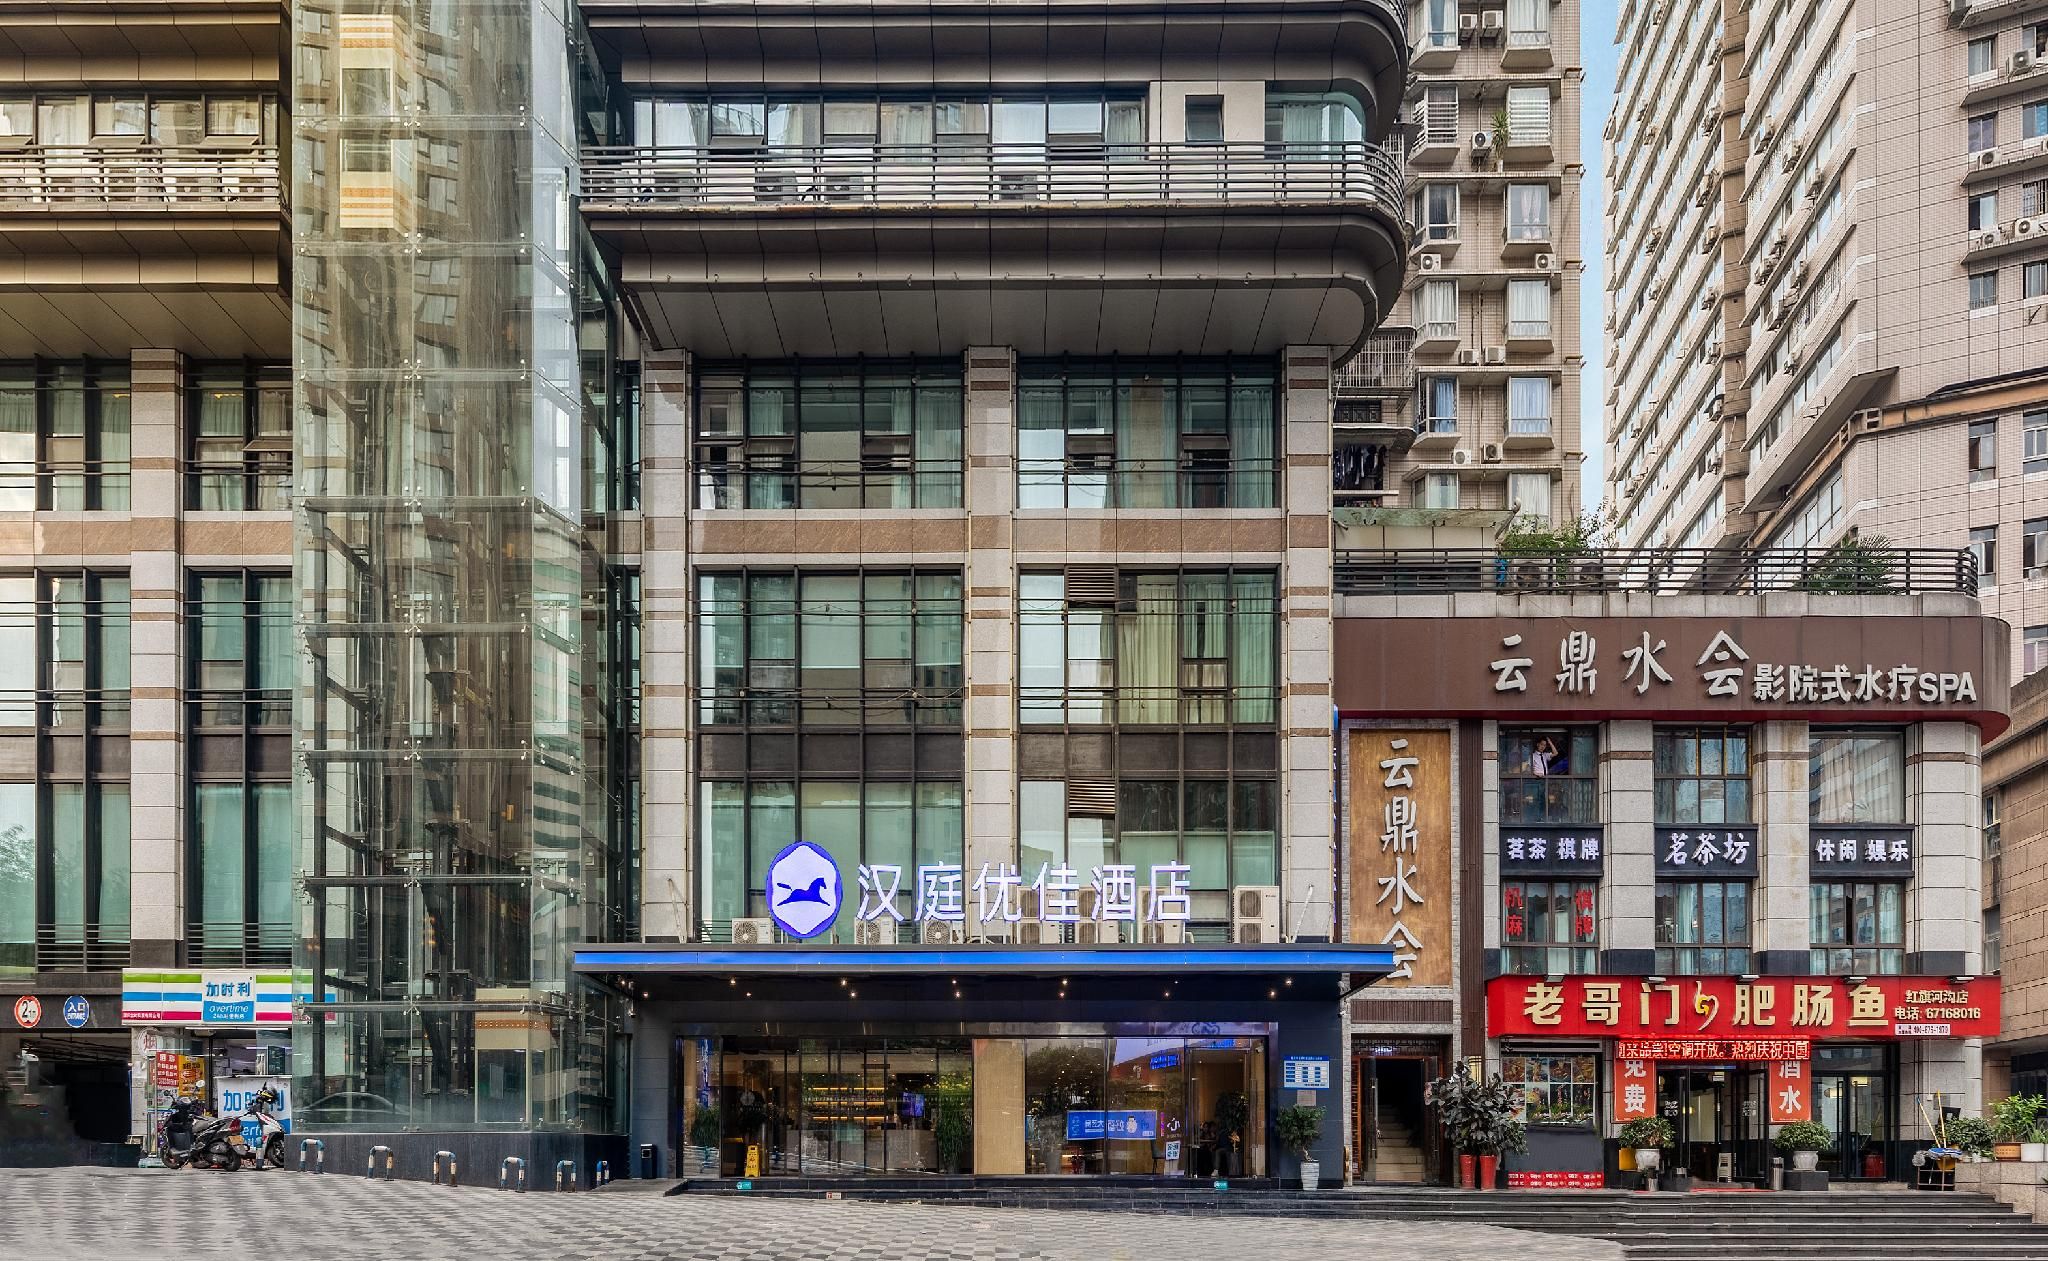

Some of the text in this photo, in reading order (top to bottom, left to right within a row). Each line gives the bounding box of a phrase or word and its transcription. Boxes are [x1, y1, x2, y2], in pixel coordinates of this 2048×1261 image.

[1489, 630, 1978, 702] 云鼎水会 影院式水疗SPA
[1376, 738, 1424, 979] 云鼎水会
[1507, 837, 1600, 860] 茗茶 棋牌
[1663, 832, 1750, 866] 茗茶坊
[1815, 838, 1909, 862] 休闲 娱乐
[857, 860, 1191, 923] 汉庭优佳酒店
[206, 981, 251, 997] 加时利
[1905, 989, 1969, 1004] 红旗河沟店
[67, 1002, 86, 1012] 入口
[209, 1003, 249, 1013] overtime
[1523, 982, 1889, 1027] 老哥门 肥肠鱼
[1926, 1007, 1981, 1019] 67168016
